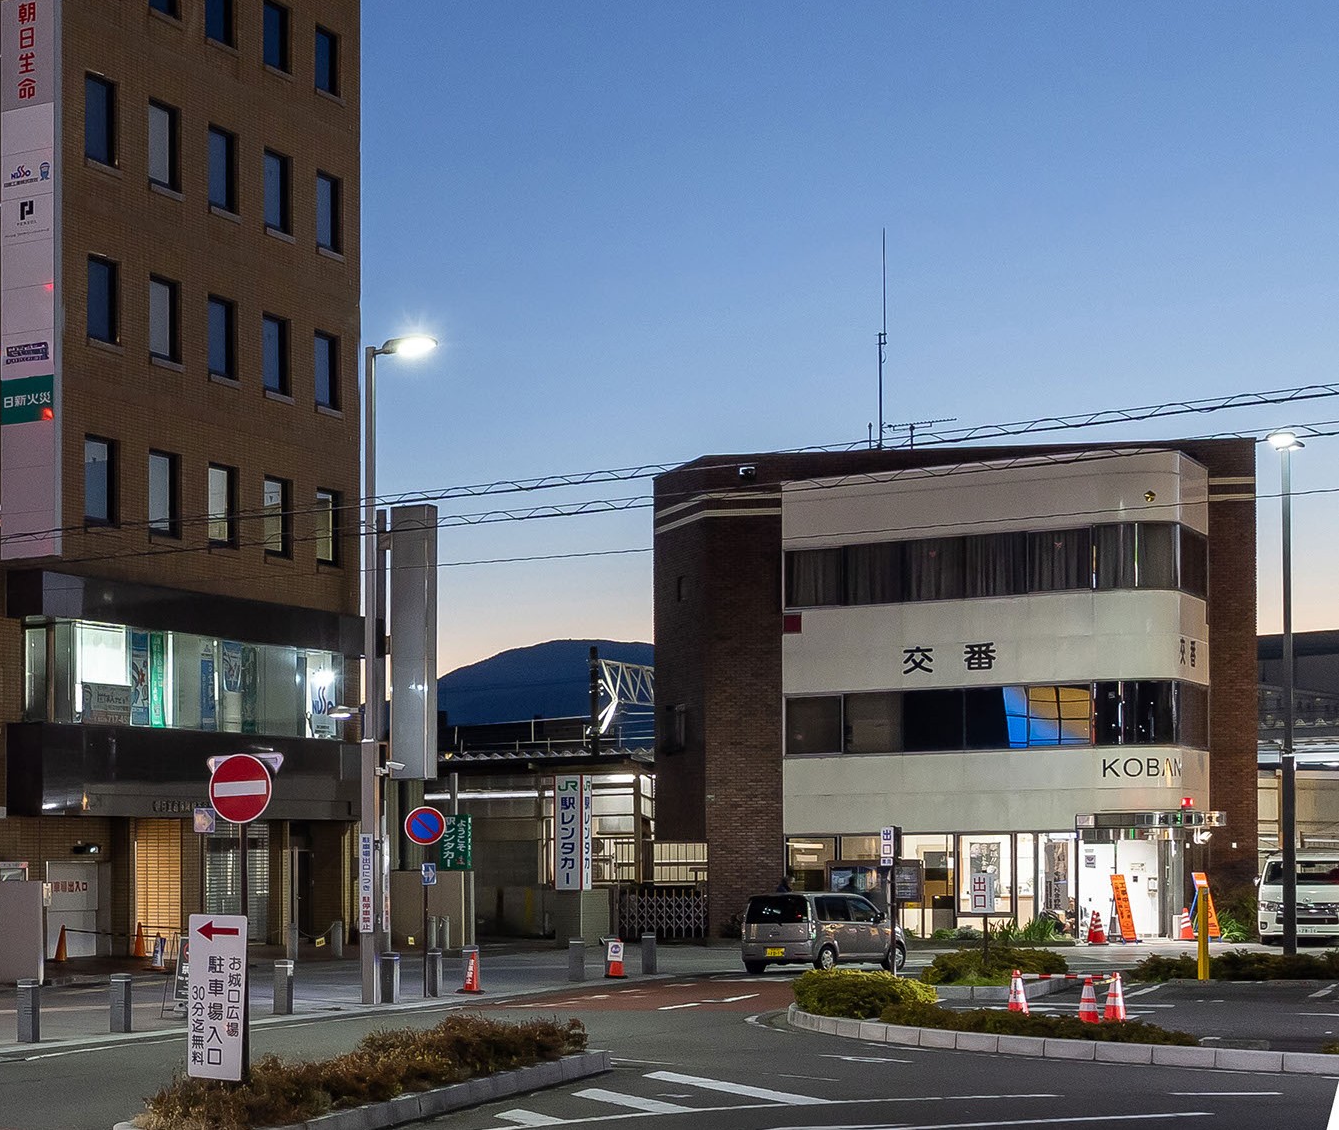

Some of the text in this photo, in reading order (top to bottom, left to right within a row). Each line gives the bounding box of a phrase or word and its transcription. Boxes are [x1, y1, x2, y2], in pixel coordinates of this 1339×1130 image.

[17, 1, 37, 99] 朝日生命
[3, 391, 51, 409] 日新火災
[902, 642, 997, 676] 交番
[1179, 638, 1197, 668] 交番
[1102, 757, 1183, 778] KOBAN
[558, 780, 578, 792] JR
[456, 819, 467, 852] ようこそ
[560, 796, 575, 884] 駅レンタカー
[882, 829, 892, 855] 出口
[51, 880, 88, 893] 車場出入口
[973, 876, 986, 909] 出口
[206, 955, 225, 1066] 駐車場入口
[225, 956, 242, 1038] お城口広場
[191, 985, 205, 1066] 30分迄無料
